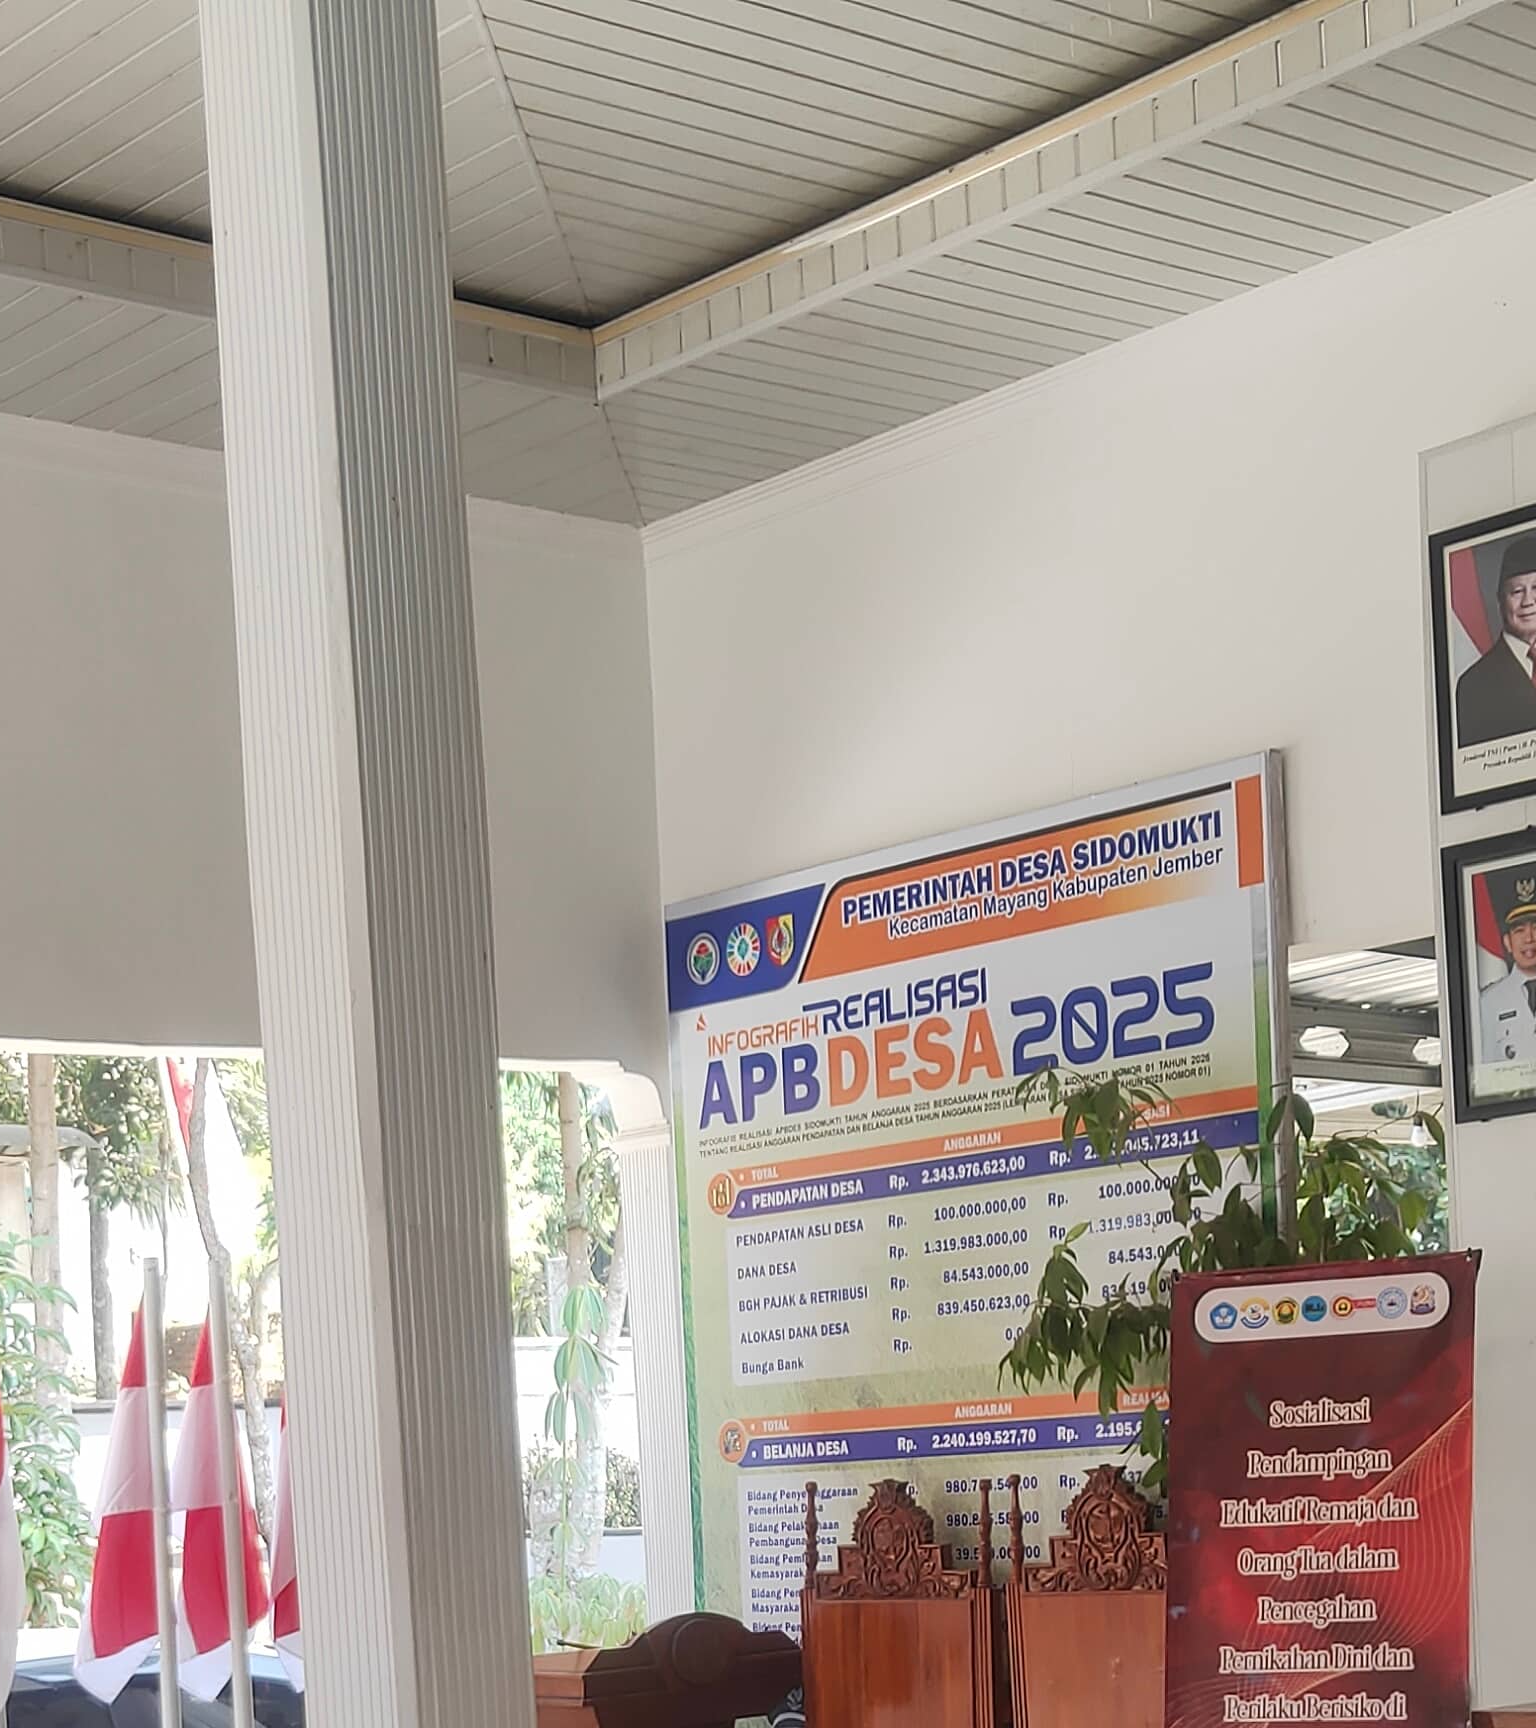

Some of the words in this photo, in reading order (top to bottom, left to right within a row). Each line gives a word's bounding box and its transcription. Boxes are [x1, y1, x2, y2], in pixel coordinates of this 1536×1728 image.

[842, 864, 995, 926] PEMERINTAH
[1000, 848, 1067, 888] DESA
[1072, 810, 1222, 870] SIDOMUKTI
[888, 901, 979, 939] Kecamatan
[983, 885, 1047, 922] Mayang
[1052, 864, 1149, 908] Kabupaten
[1152, 845, 1224, 882] Jember
[803, 967, 987, 1034] REALISASI
[1010, 961, 1215, 1077] 2025
[751, 1167, 779, 1180] TOTAL
[944, 1133, 1001, 1152] ANGGARAN
[752, 1186, 830, 1209] PENDAPATAN
[832, 1179, 864, 1198] DESA
[889, 1174, 909, 1191] Rp.
[921, 1155, 1026, 1184] 2.343.976.623,00
[1050, 1150, 1070, 1166] Rp.
[736, 1226, 805, 1248] PENDAPATAN
[808, 1223, 832, 1238] ASLI
[835, 1219, 864, 1234] DESA
[888, 1214, 907, 1229] Rp.
[934, 1196, 1027, 1221] 100.000.000,00
[1048, 1192, 1068, 1208] Rp.
[737, 1265, 766, 1280] DANA
[769, 1261, 796, 1277] DESA
[889, 1245, 908, 1260] Rp.
[924, 1229, 1028, 1255] 1.319.983.000,00
[1049, 1225, 1066, 1240] Rp
[738, 1299, 761, 1312] BGH
[763, 1295, 796, 1310] PAJAK
[799, 1293, 807, 1306] &
[810, 1285, 868, 1305] RETRIBUSI
[890, 1276, 909, 1291] Rp.
[943, 1261, 1029, 1284] 84.543.000,00
[740, 1327, 786, 1345] ALOKASI
[788, 1325, 817, 1340] DANA
[820, 1321, 850, 1336] DESA
[892, 1307, 911, 1322] Rp.
[937, 1294, 1030, 1317] 839.450.623,00
[741, 1360, 775, 1375] Bunga
[777, 1357, 804, 1370] Bank
[893, 1339, 912, 1354] Rp.
[763, 1421, 790, 1432] TOTAL
[954, 1404, 1012, 1419] ANGGARAN
[1270, 1398, 1370, 1427] Sosialisasi
[764, 1442, 815, 1459] BELANJA
[817, 1440, 849, 1455] DESA
[897, 1437, 917, 1453] Rp.
[932, 1428, 1037, 1449] 2.240.199.527,70
[1057, 1426, 1079, 1442] Rp.
[1248, 1449, 1391, 1479] Pendampingan
[748, 1491, 777, 1502] Bidang
[1059, 1474, 1080, 1489] Rp.
[748, 1504, 799, 1515] Pemerintah
[1221, 1497, 1302, 1526] Edukatif
[1304, 1496, 1375, 1526] Remaja
[1379, 1494, 1418, 1520] dan
[749, 1522, 779, 1534] Bidang
[750, 1555, 780, 1566] Bidang
[1239, 1548, 1296, 1580] Orang
[1298, 1546, 1332, 1573] Tua
[1336, 1545, 1398, 1572] dalam
[751, 1589, 781, 1600] Bidang
[752, 1603, 800, 1615] Masyaraka
[1258, 1595, 1376, 1627] Pencegahan
[1220, 1645, 1330, 1673] Pernikahan
[1332, 1644, 1372, 1670] Dini
[1373, 1642, 1413, 1670] dan
[1224, 1694, 1303, 1722] Perilaku
[1305, 1693, 1383, 1721] Berisiko
[1385, 1692, 1407, 1719] di
